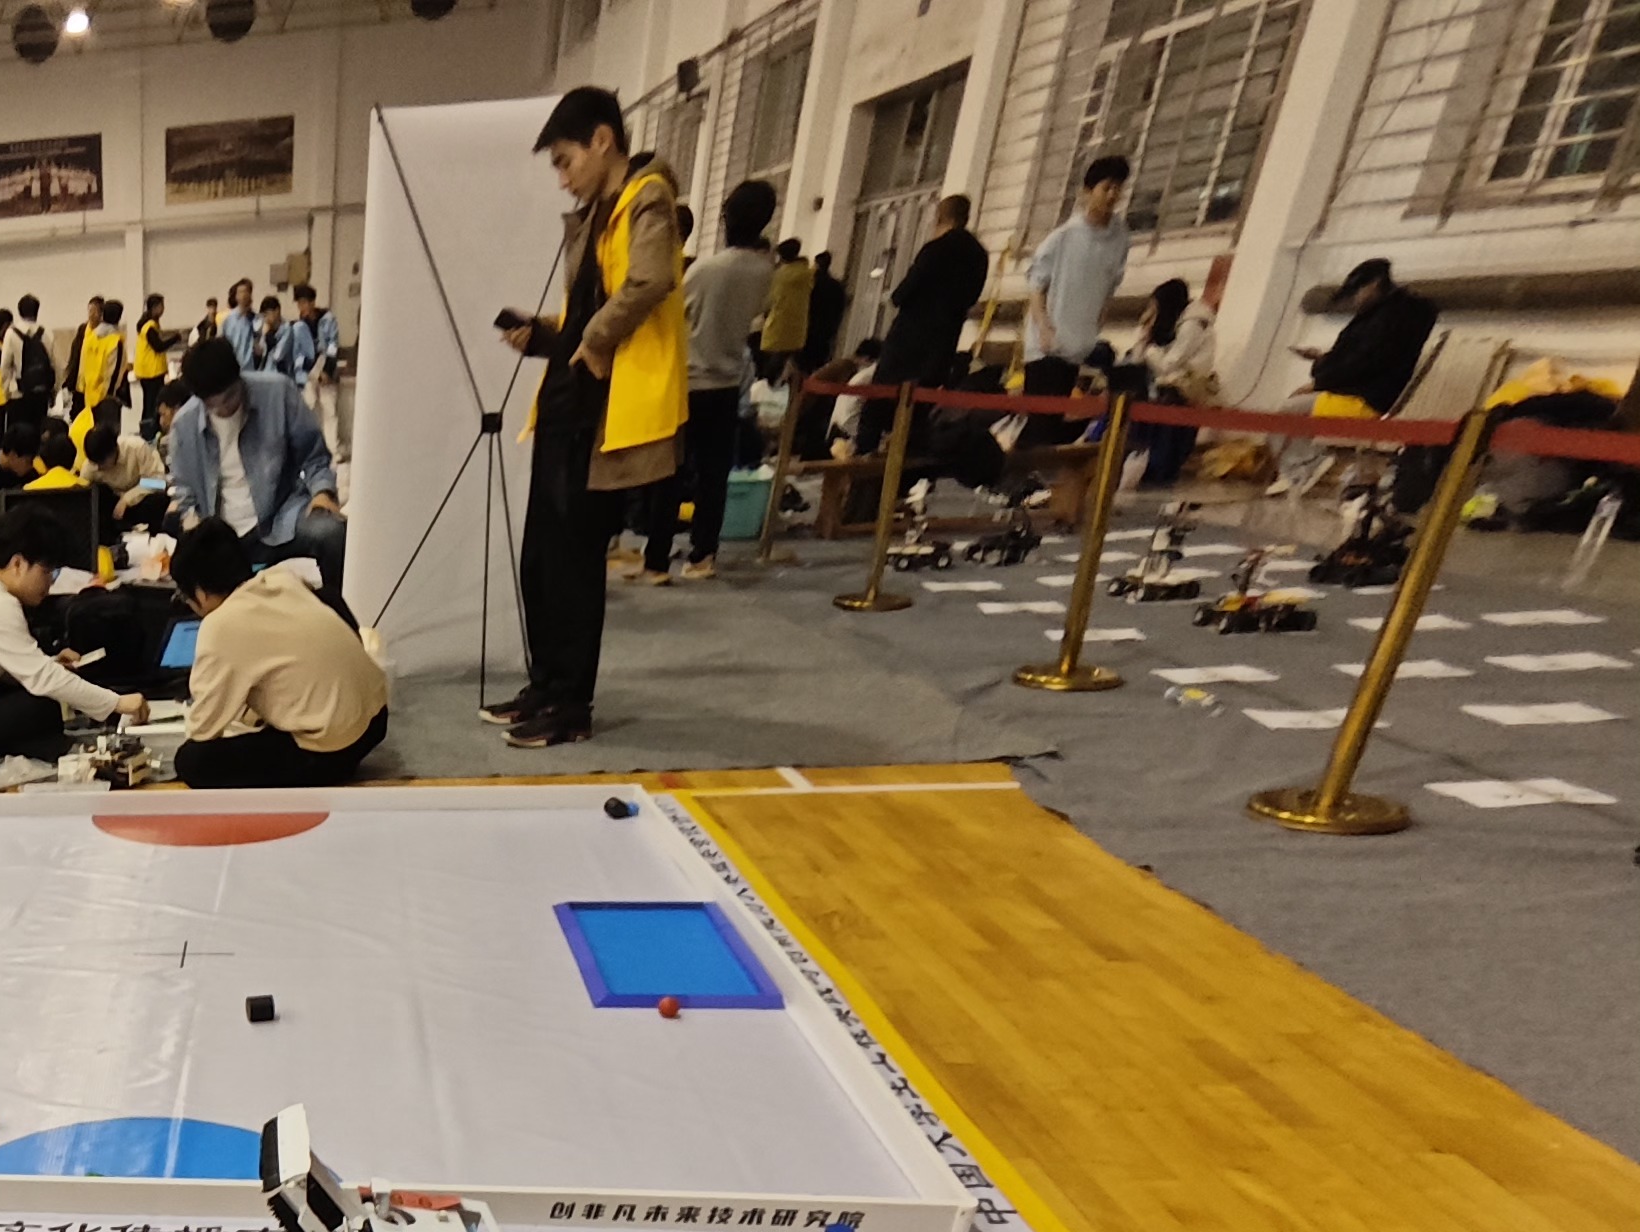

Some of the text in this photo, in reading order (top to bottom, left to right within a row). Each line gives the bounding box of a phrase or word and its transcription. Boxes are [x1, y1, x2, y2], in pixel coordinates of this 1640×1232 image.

[549, 1201, 866, 1230] 创非凡未来技术研究院
